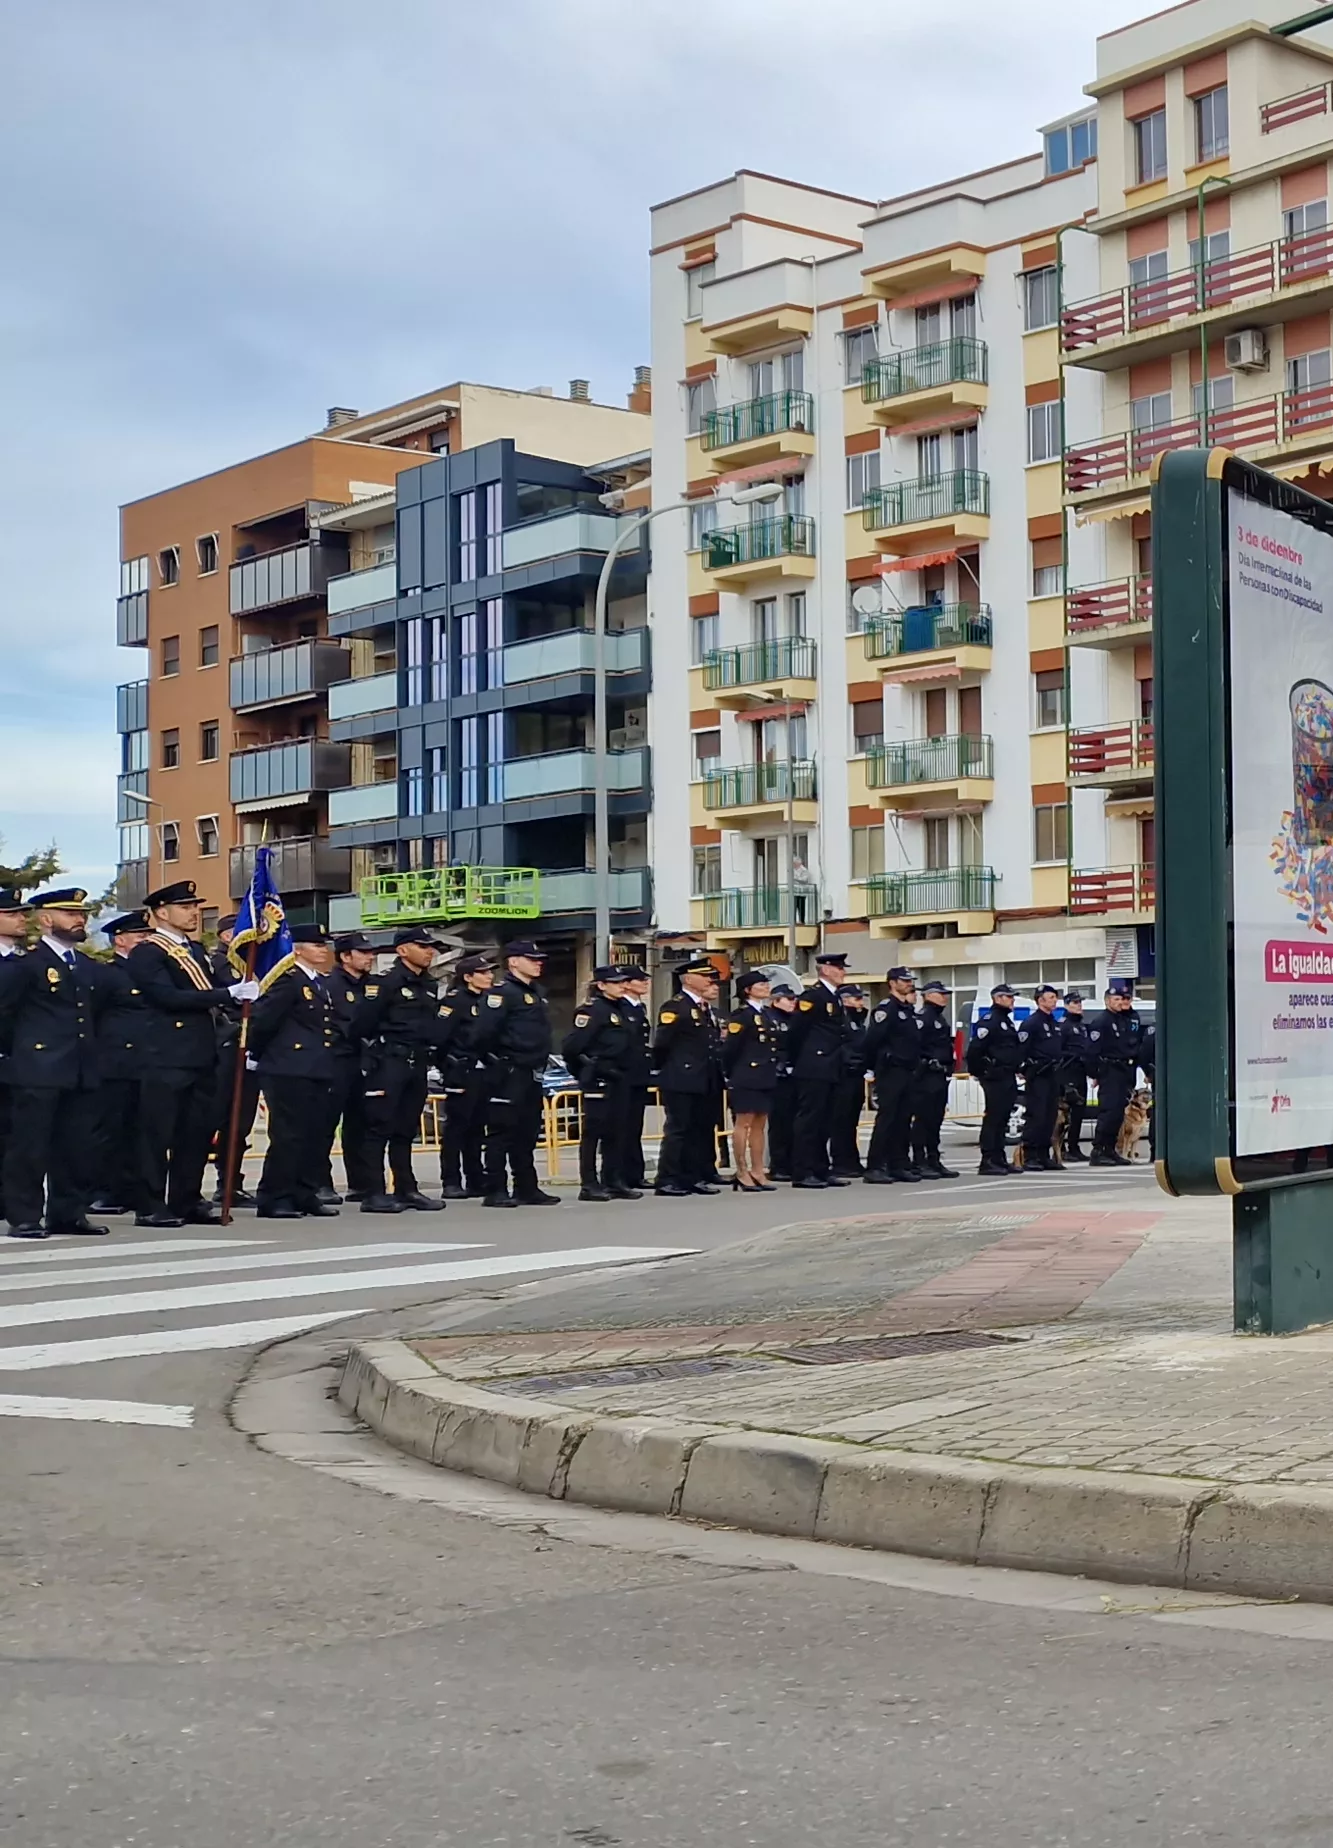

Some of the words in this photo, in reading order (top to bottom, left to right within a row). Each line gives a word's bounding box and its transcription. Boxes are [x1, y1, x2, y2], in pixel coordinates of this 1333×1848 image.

[1237, 525, 1244, 542] 3
[1246, 529, 1259, 548] de
[1239, 571, 1271, 593] Personas
[1293, 573, 1303, 587] de
[1303, 576, 1312, 591] las
[478, 906, 529, 915] ZOOMLION
[1271, 948, 1287, 974] La
[1288, 991, 1320, 1010] aparece
[1272, 1013, 1316, 1031] eliminamos
[1316, 1013, 1328, 1030] las
